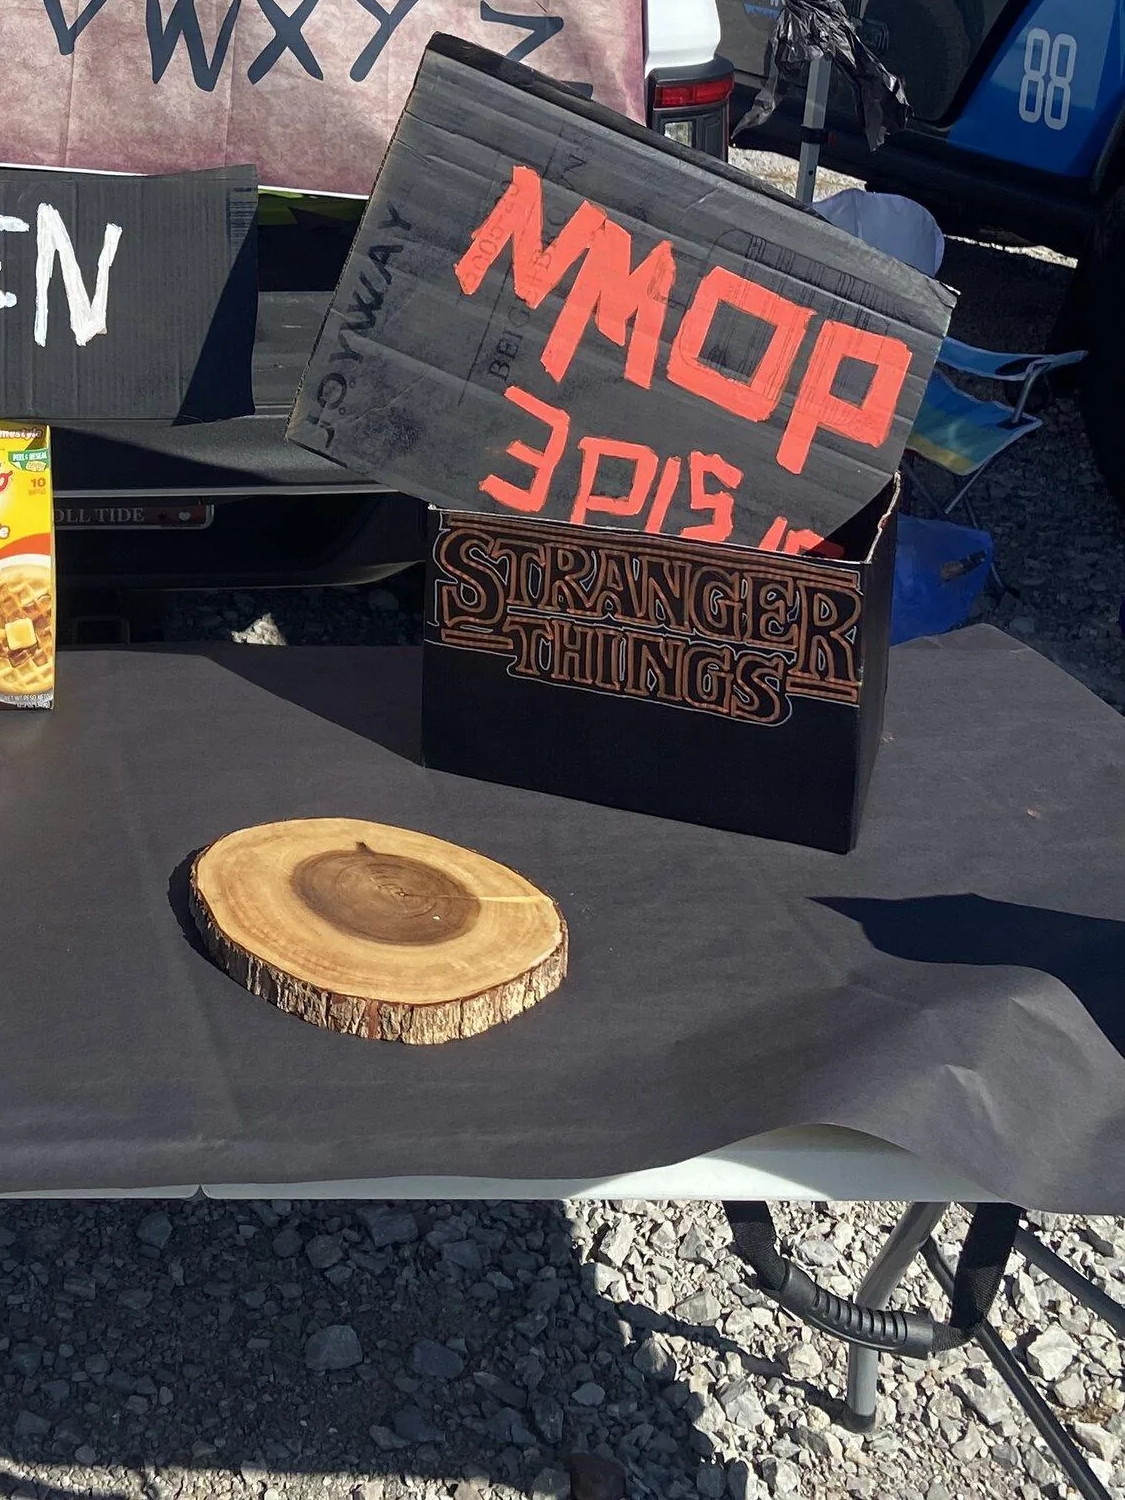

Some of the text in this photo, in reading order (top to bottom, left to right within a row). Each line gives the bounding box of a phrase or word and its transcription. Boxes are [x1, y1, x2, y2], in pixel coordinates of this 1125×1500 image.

[1018, 27, 1077, 131] 88
[30, 478, 46, 488] 10
[55, 507, 145, 523] OLL TIDE
[438, 526, 863, 684] STRANGER
[503, 614, 788, 722] THINGS
